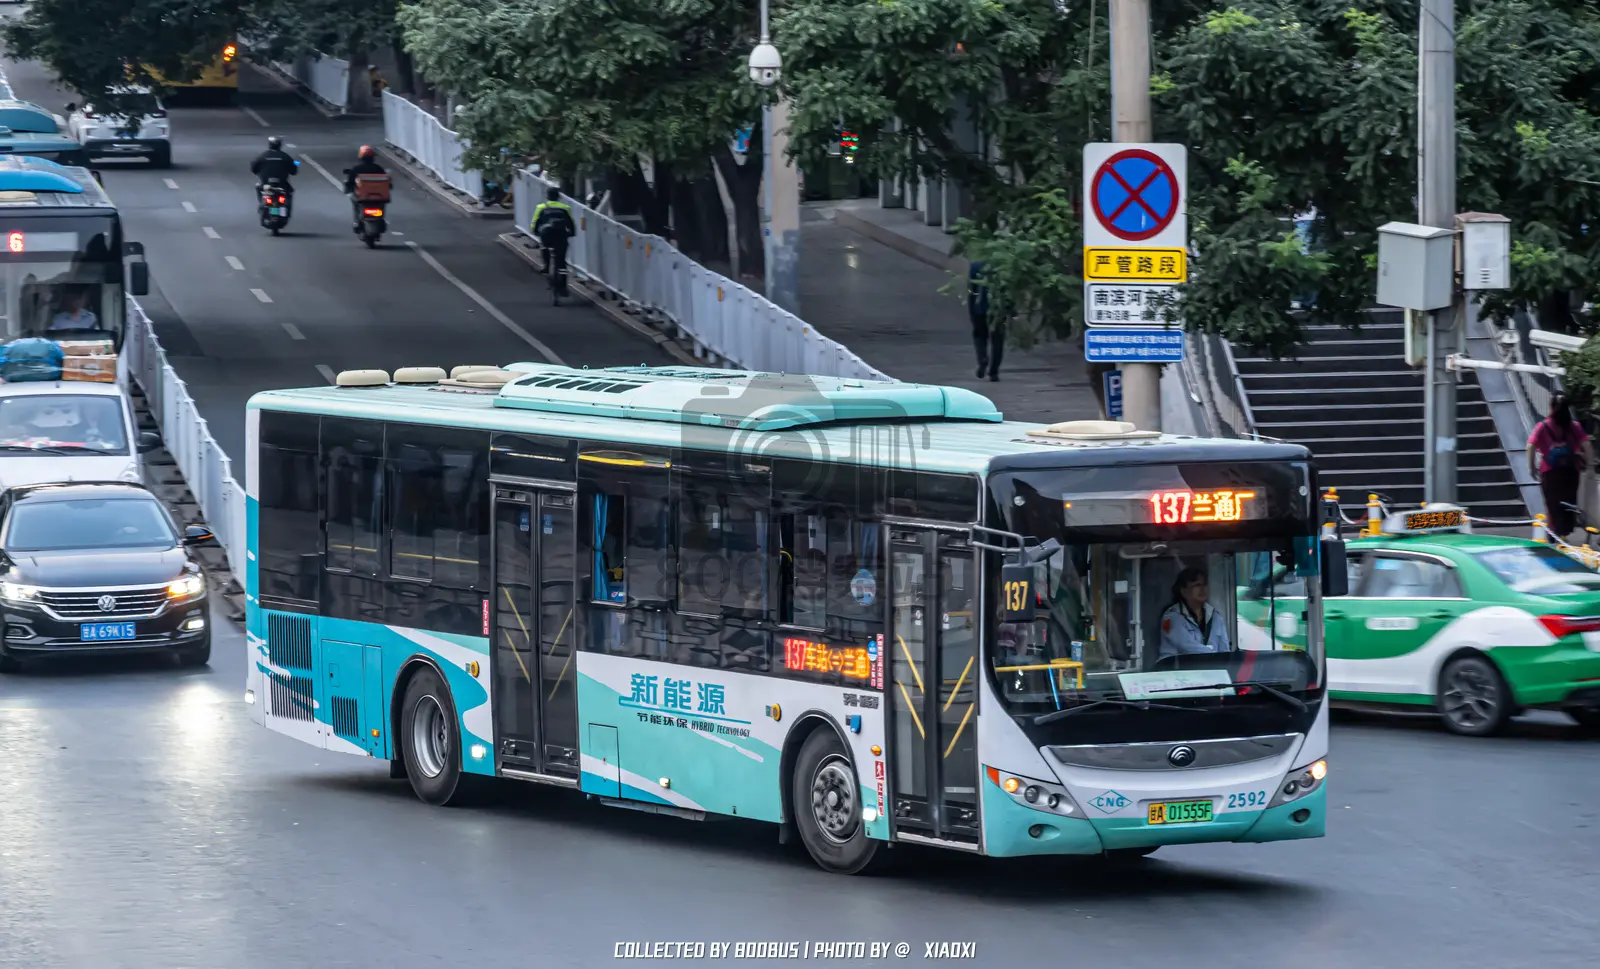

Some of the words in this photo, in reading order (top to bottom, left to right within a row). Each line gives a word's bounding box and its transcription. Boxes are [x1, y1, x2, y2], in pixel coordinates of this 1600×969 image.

[9, 233, 24, 252] 6
[1094, 255, 1176, 273] 严管路段
[1004, 581, 1028, 611] 137
[630, 673, 725, 715] 新能源
[637, 712, 688, 729] 节能环保
[691, 720, 715, 733] HYBRID
[717, 725, 750, 737] TECHNOLOGY
[1097, 797, 1125, 808] CNG
[1228, 791, 1266, 808] 2592
